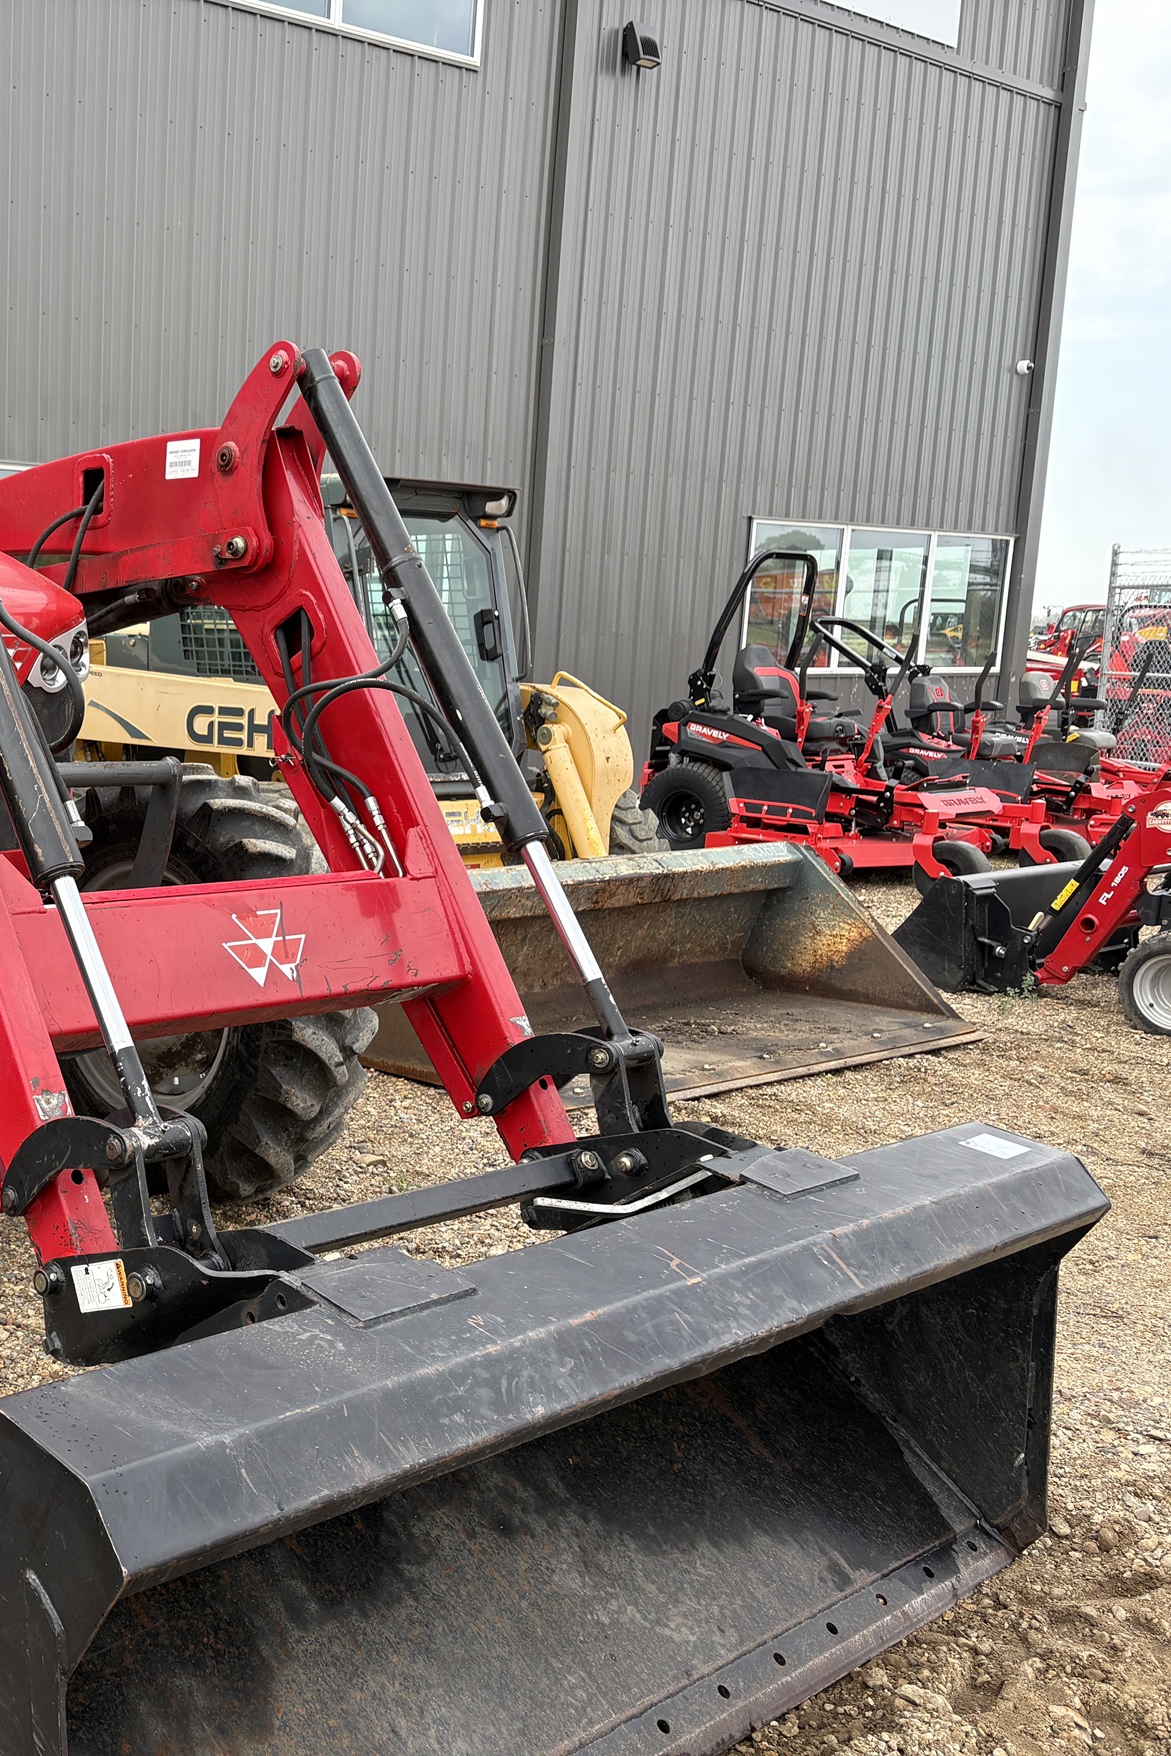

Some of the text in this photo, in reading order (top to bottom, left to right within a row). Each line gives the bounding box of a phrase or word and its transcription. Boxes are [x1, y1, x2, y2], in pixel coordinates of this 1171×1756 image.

[186, 704, 275, 751] GEH
[689, 722, 730, 740] GRAVELY
[908, 747, 943, 759] GRAVELY
[1098, 865, 1129, 906] FL 1805
[116, 1268, 129, 1305] WARNING
